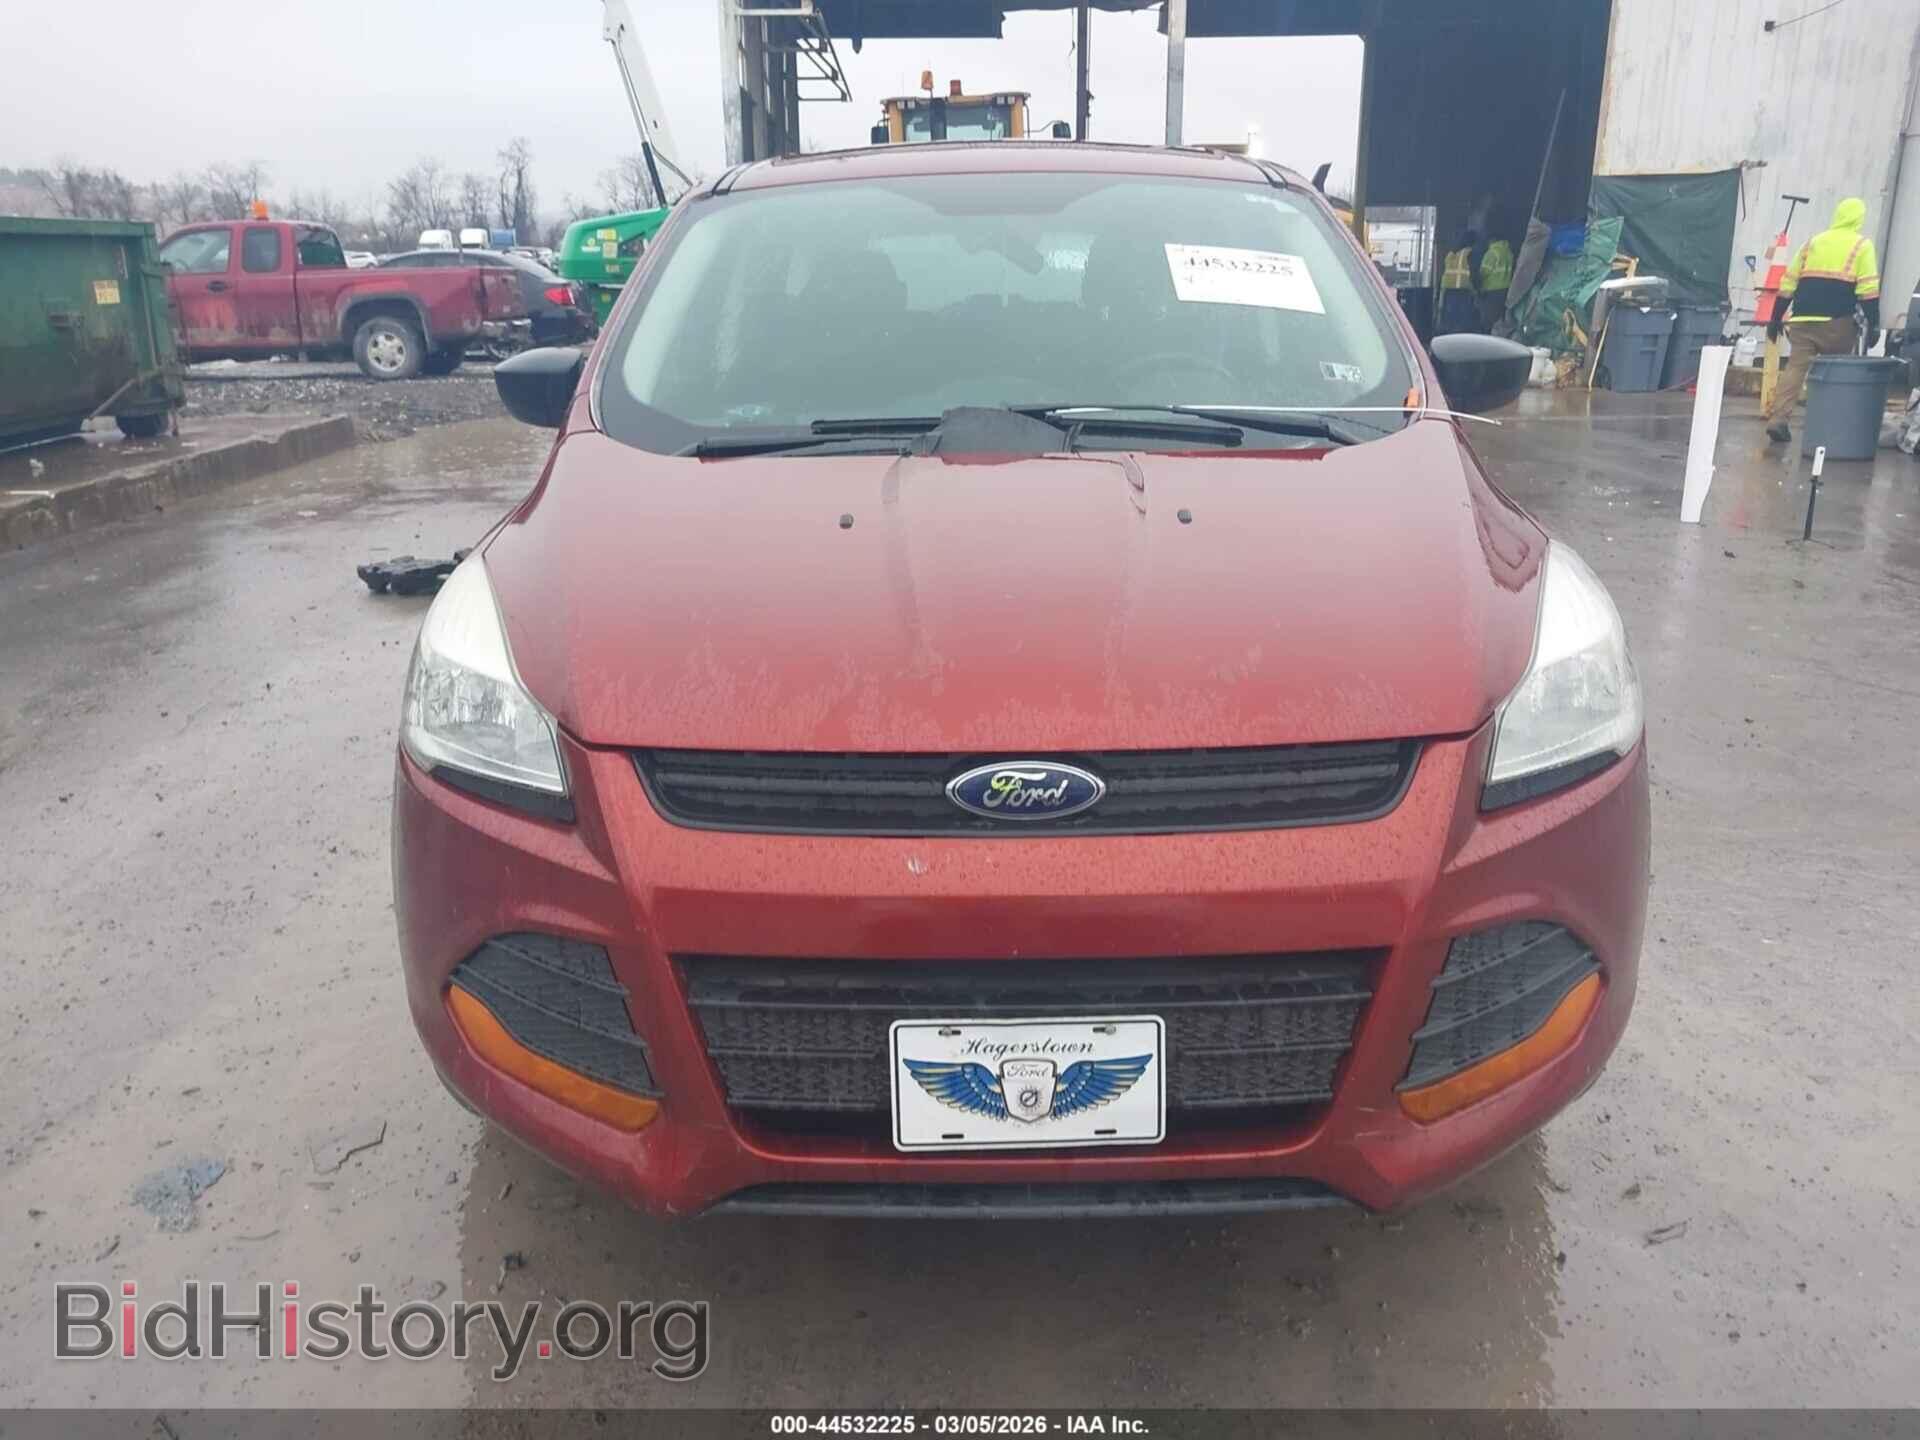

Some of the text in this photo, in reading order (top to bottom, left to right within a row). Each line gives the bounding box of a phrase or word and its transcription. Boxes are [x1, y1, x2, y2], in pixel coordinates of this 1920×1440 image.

[983, 771, 1068, 807] Ford
[960, 1037, 1095, 1060] Hagerstown
[1006, 1063, 1049, 1079] Ford
